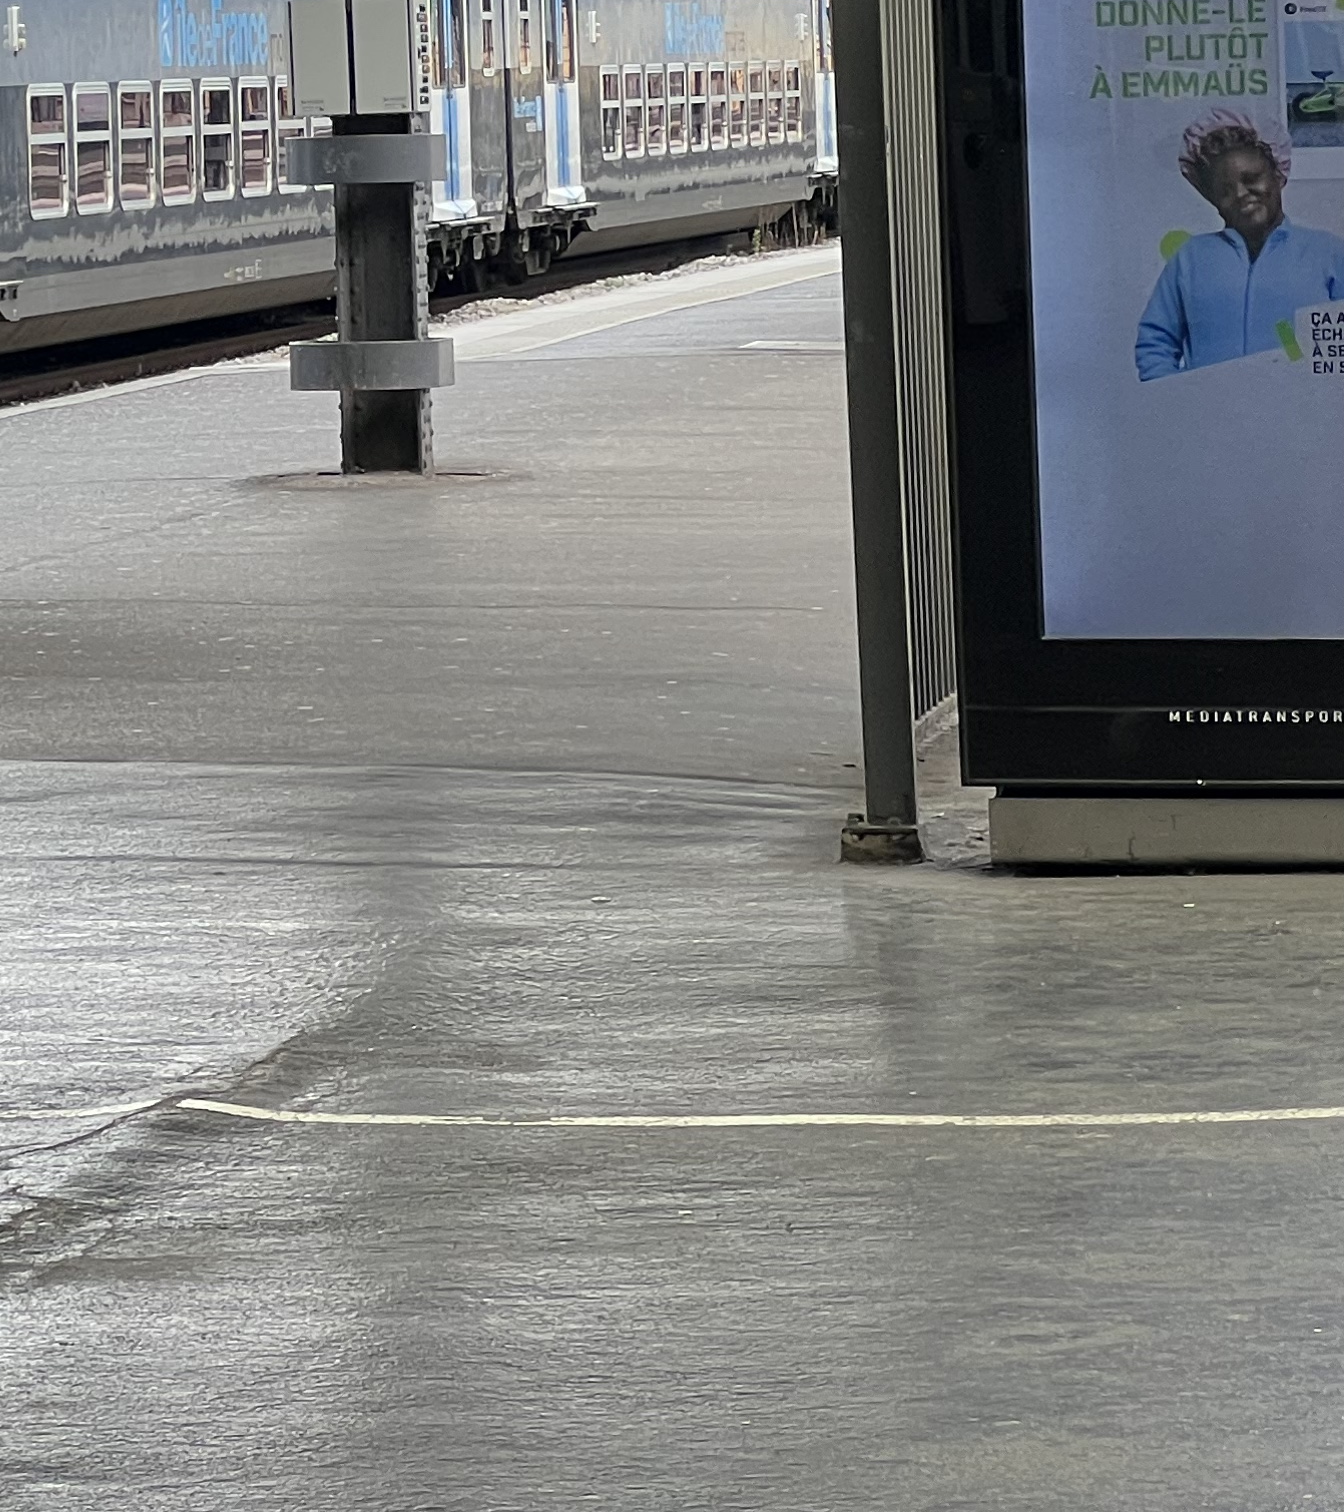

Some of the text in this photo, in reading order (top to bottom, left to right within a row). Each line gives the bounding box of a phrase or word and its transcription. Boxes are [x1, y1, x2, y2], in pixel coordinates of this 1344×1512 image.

[1144, 27, 1268, 61] PLUTÔT
[1090, 63, 1268, 99] À EMMAÜS
[1311, 312, 1332, 328] ÇA
[1312, 342, 1323, 358] À
[1313, 361, 1334, 374] EN
